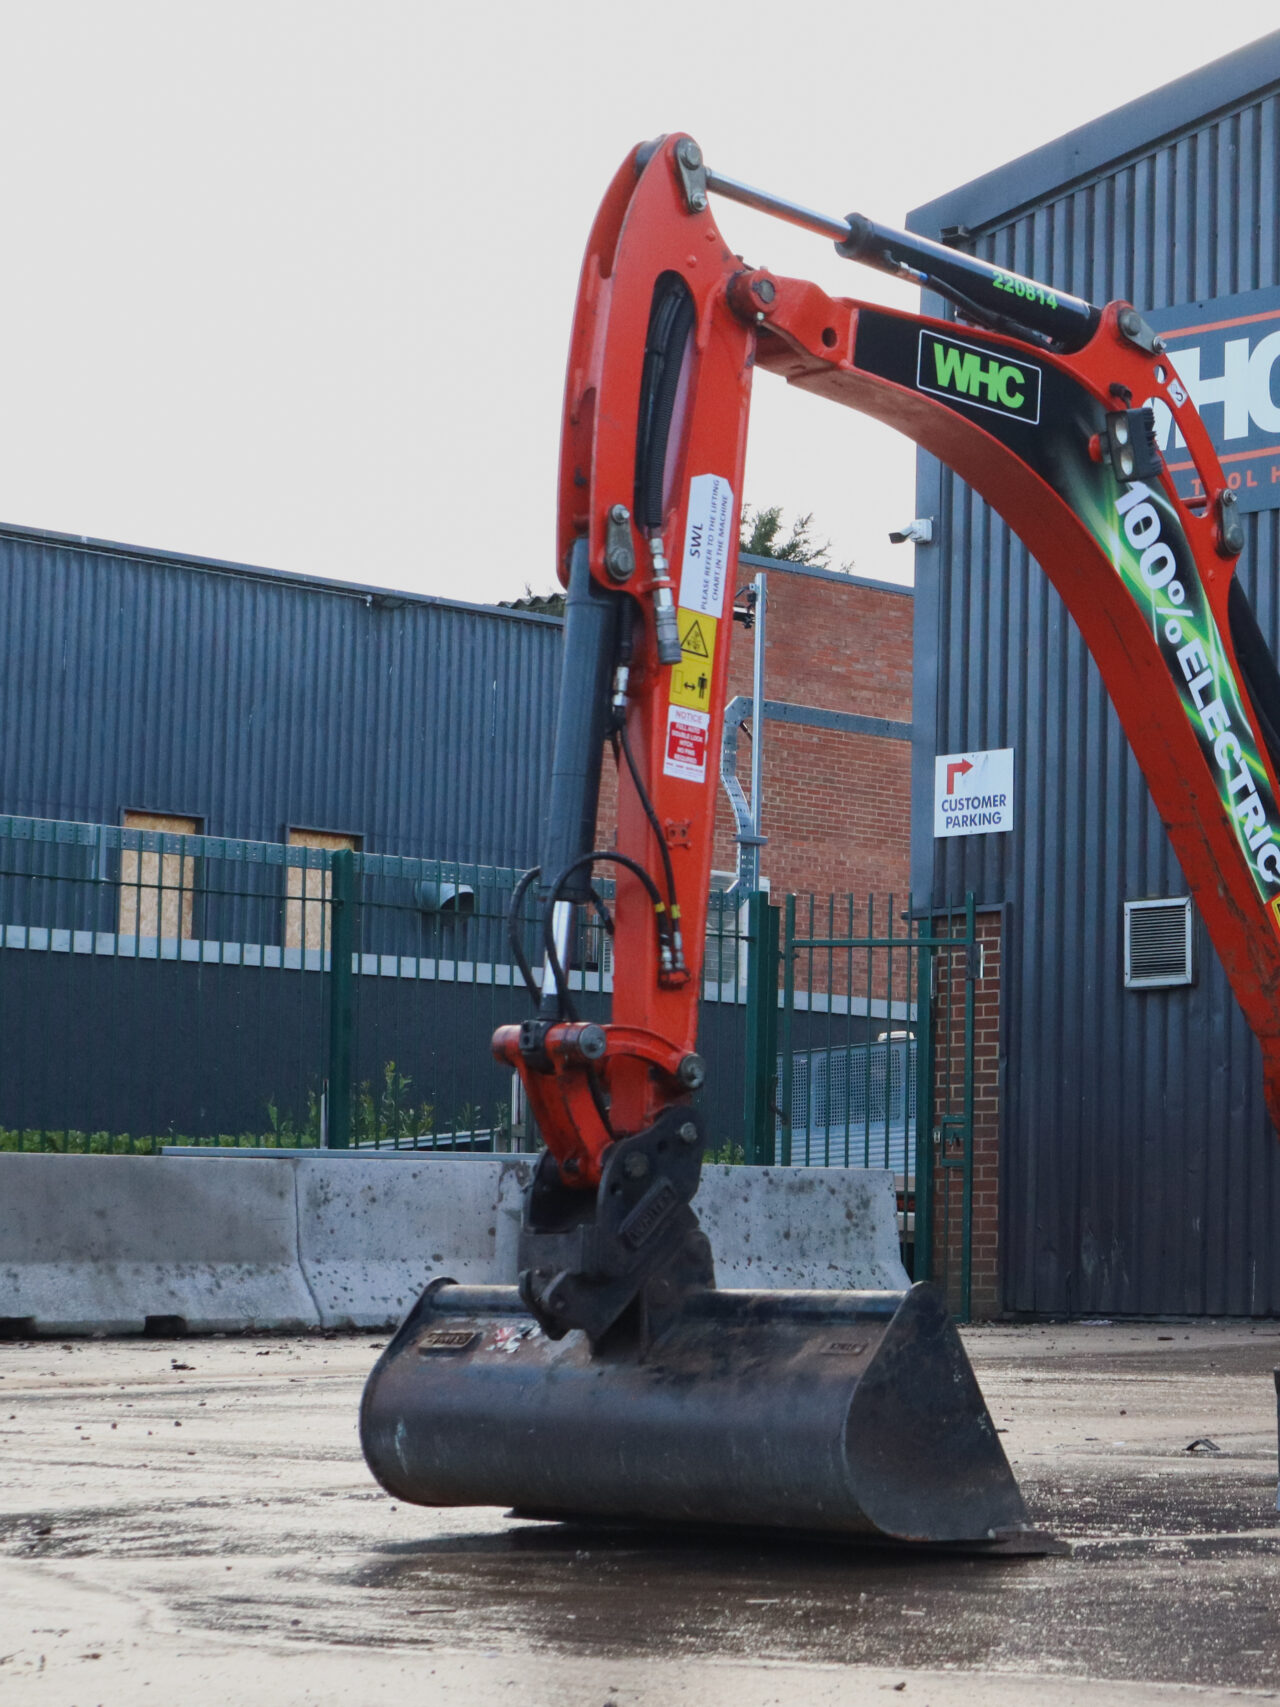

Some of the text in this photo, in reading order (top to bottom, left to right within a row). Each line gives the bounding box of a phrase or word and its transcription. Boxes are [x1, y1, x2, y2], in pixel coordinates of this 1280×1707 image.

[992, 270, 1058, 310] 220814
[933, 342, 1026, 409] WHC
[711, 479, 720, 514] LIFTING
[1191, 468, 1258, 496] TOL
[708, 516, 717, 532] THE
[718, 495, 728, 538] MACHINE
[690, 523, 704, 559] SWL
[716, 540, 725, 556] THE
[704, 549, 713, 577] REFER
[1114, 481, 1194, 644] 100%
[701, 579, 710, 610] PLEASE
[711, 571, 721, 601] CHART
[676, 711, 702, 722] NOTICE
[941, 794, 1007, 813] CUSTOMER
[945, 811, 1002, 830] PARKING
